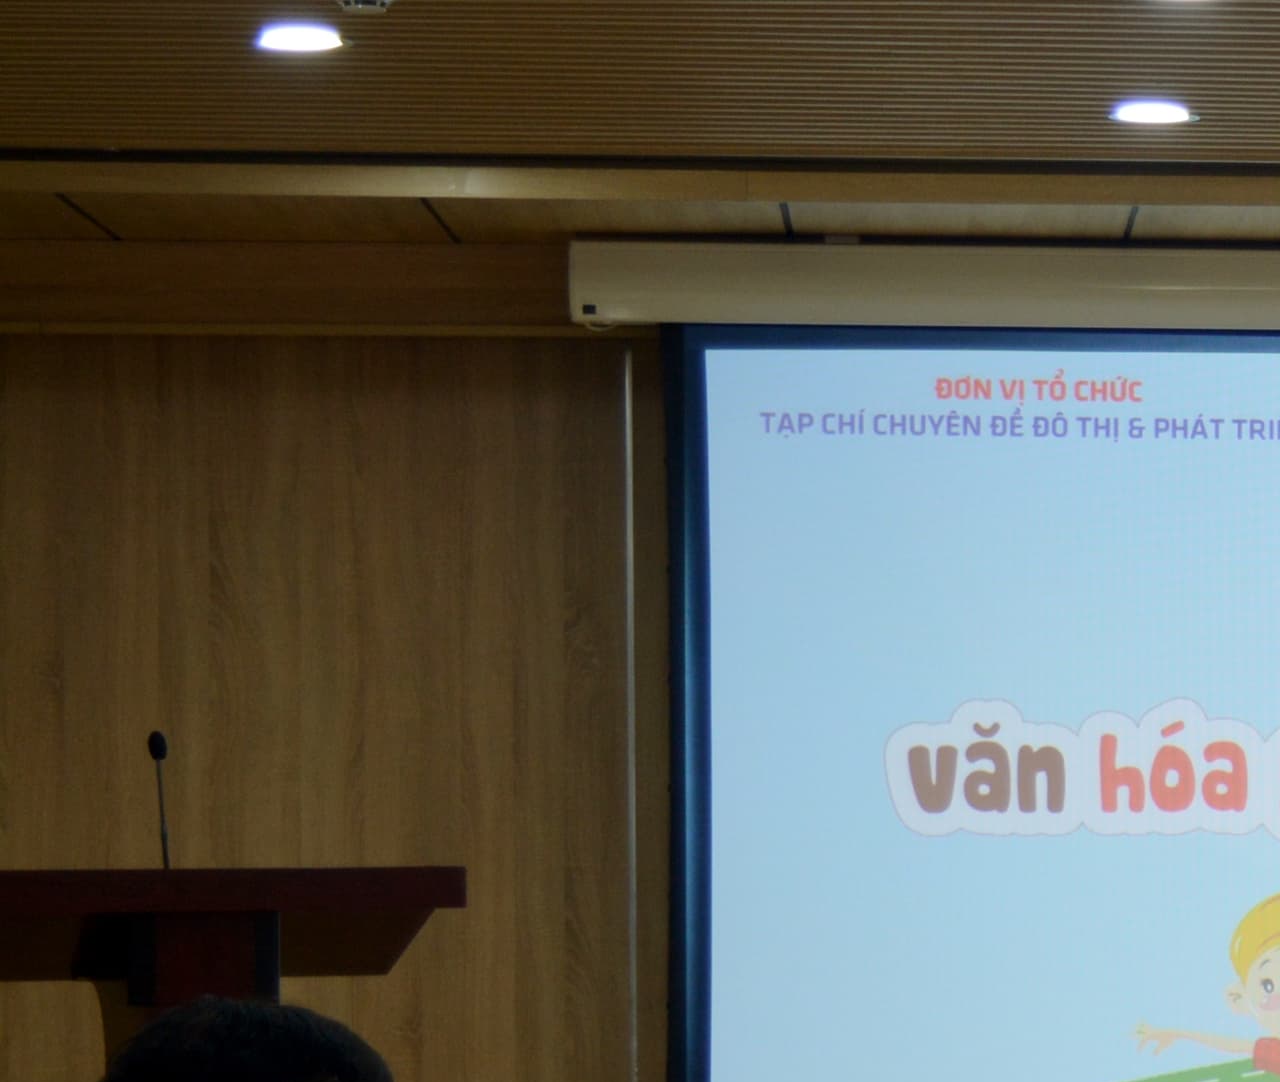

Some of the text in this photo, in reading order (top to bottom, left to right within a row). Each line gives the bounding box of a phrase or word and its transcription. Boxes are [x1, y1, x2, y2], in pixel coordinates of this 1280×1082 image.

[935, 368, 1143, 406] ĐƠN VỊ TỔ CHỨC
[759, 411, 814, 439] TẠP
[821, 408, 865, 436] CHÍ
[873, 410, 981, 437] CHUYÊN
[1032, 412, 1068, 438] ĐÔ
[1076, 416, 1119, 443] THỊ
[1128, 417, 1145, 439] &
[1154, 413, 1224, 440] PHÁT
[907, 721, 1066, 814] văn
[1099, 720, 1249, 814] hóa
